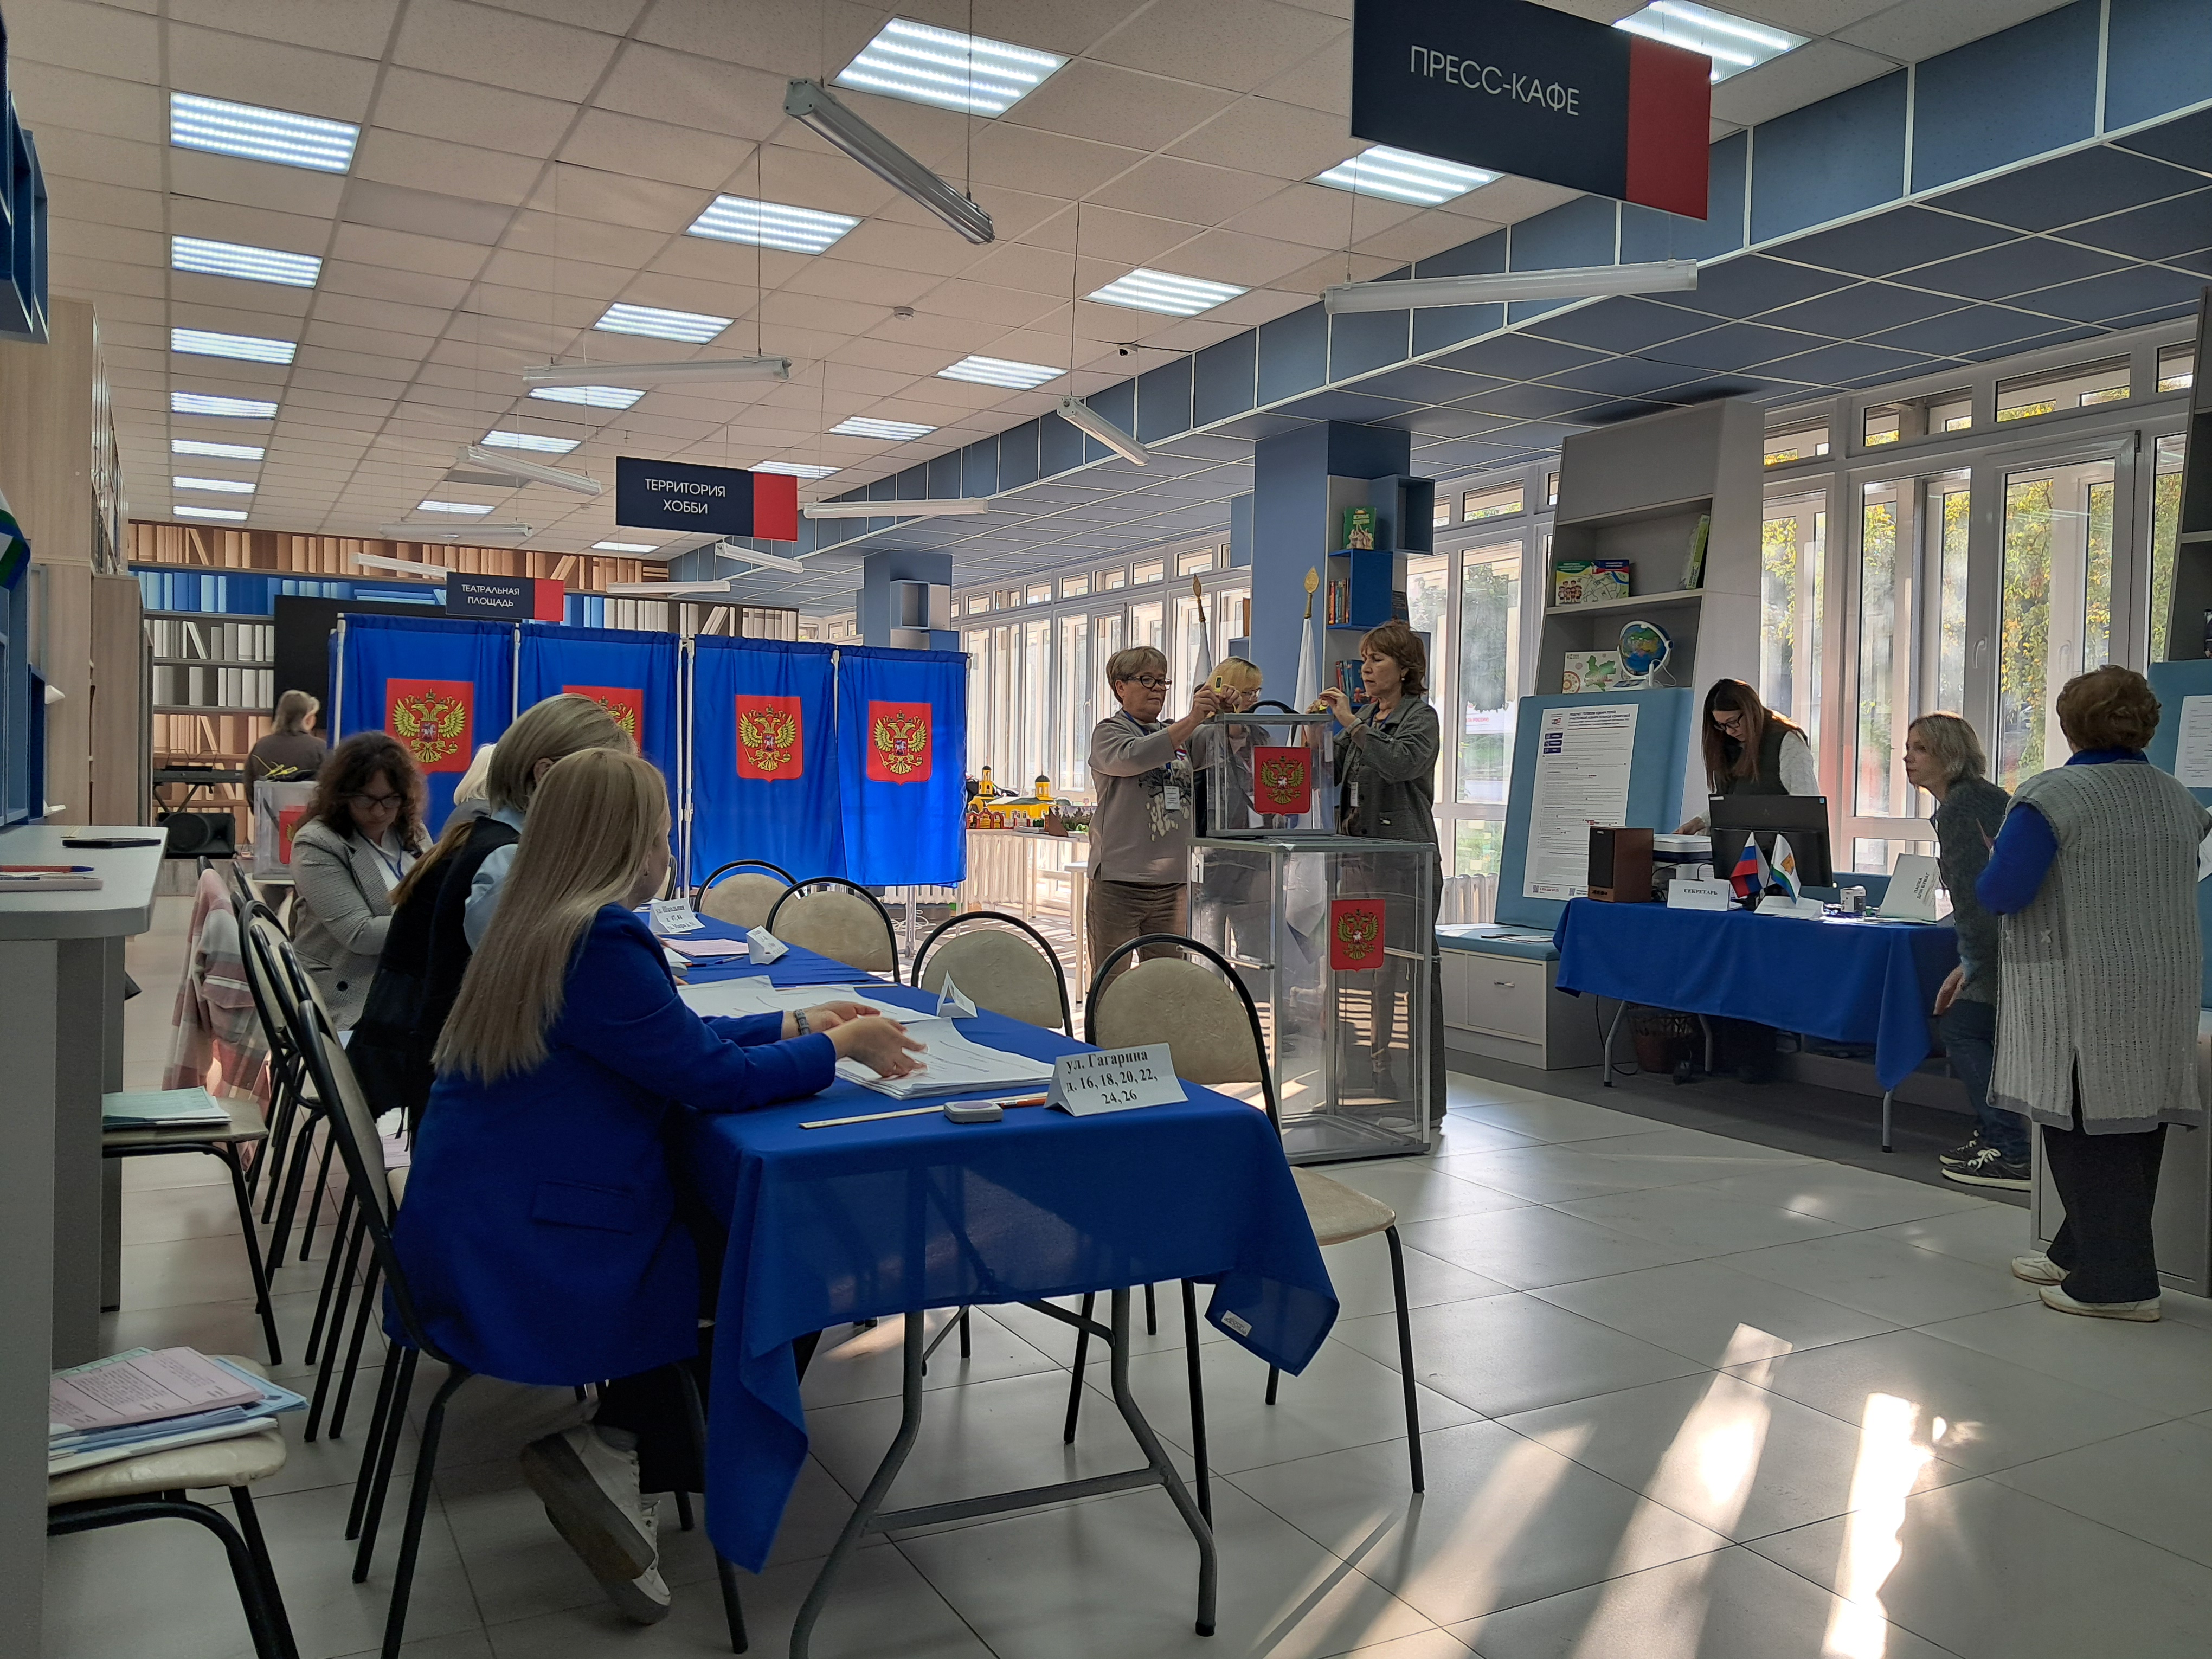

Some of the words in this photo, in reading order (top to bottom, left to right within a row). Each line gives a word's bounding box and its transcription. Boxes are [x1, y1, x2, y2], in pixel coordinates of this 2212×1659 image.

[1411, 45, 1580, 116] ПРЕСС-КАФЕ
[645, 478, 726, 498] ТЕРРИТОРИЯ
[663, 499, 708, 515] ХОББИ
[461, 584, 519, 596] ТЕАТРАЛЬНАЯ
[467, 596, 514, 608] ПЛОЩАДЬ
[1066, 1059, 1085, 1074] ул.
[1088, 1051, 1148, 1068] Гагарина
[1066, 1081, 1077, 1092] д.
[1079, 1076, 1098, 1090] 16,
[1100, 1073, 1118, 1087] 18,
[1120, 1070, 1138, 1084] 20,
[1139, 1068, 1158, 1082] 22,
[1101, 1092, 1122, 1104] 24,
[1122, 1089, 1137, 1102] 26
